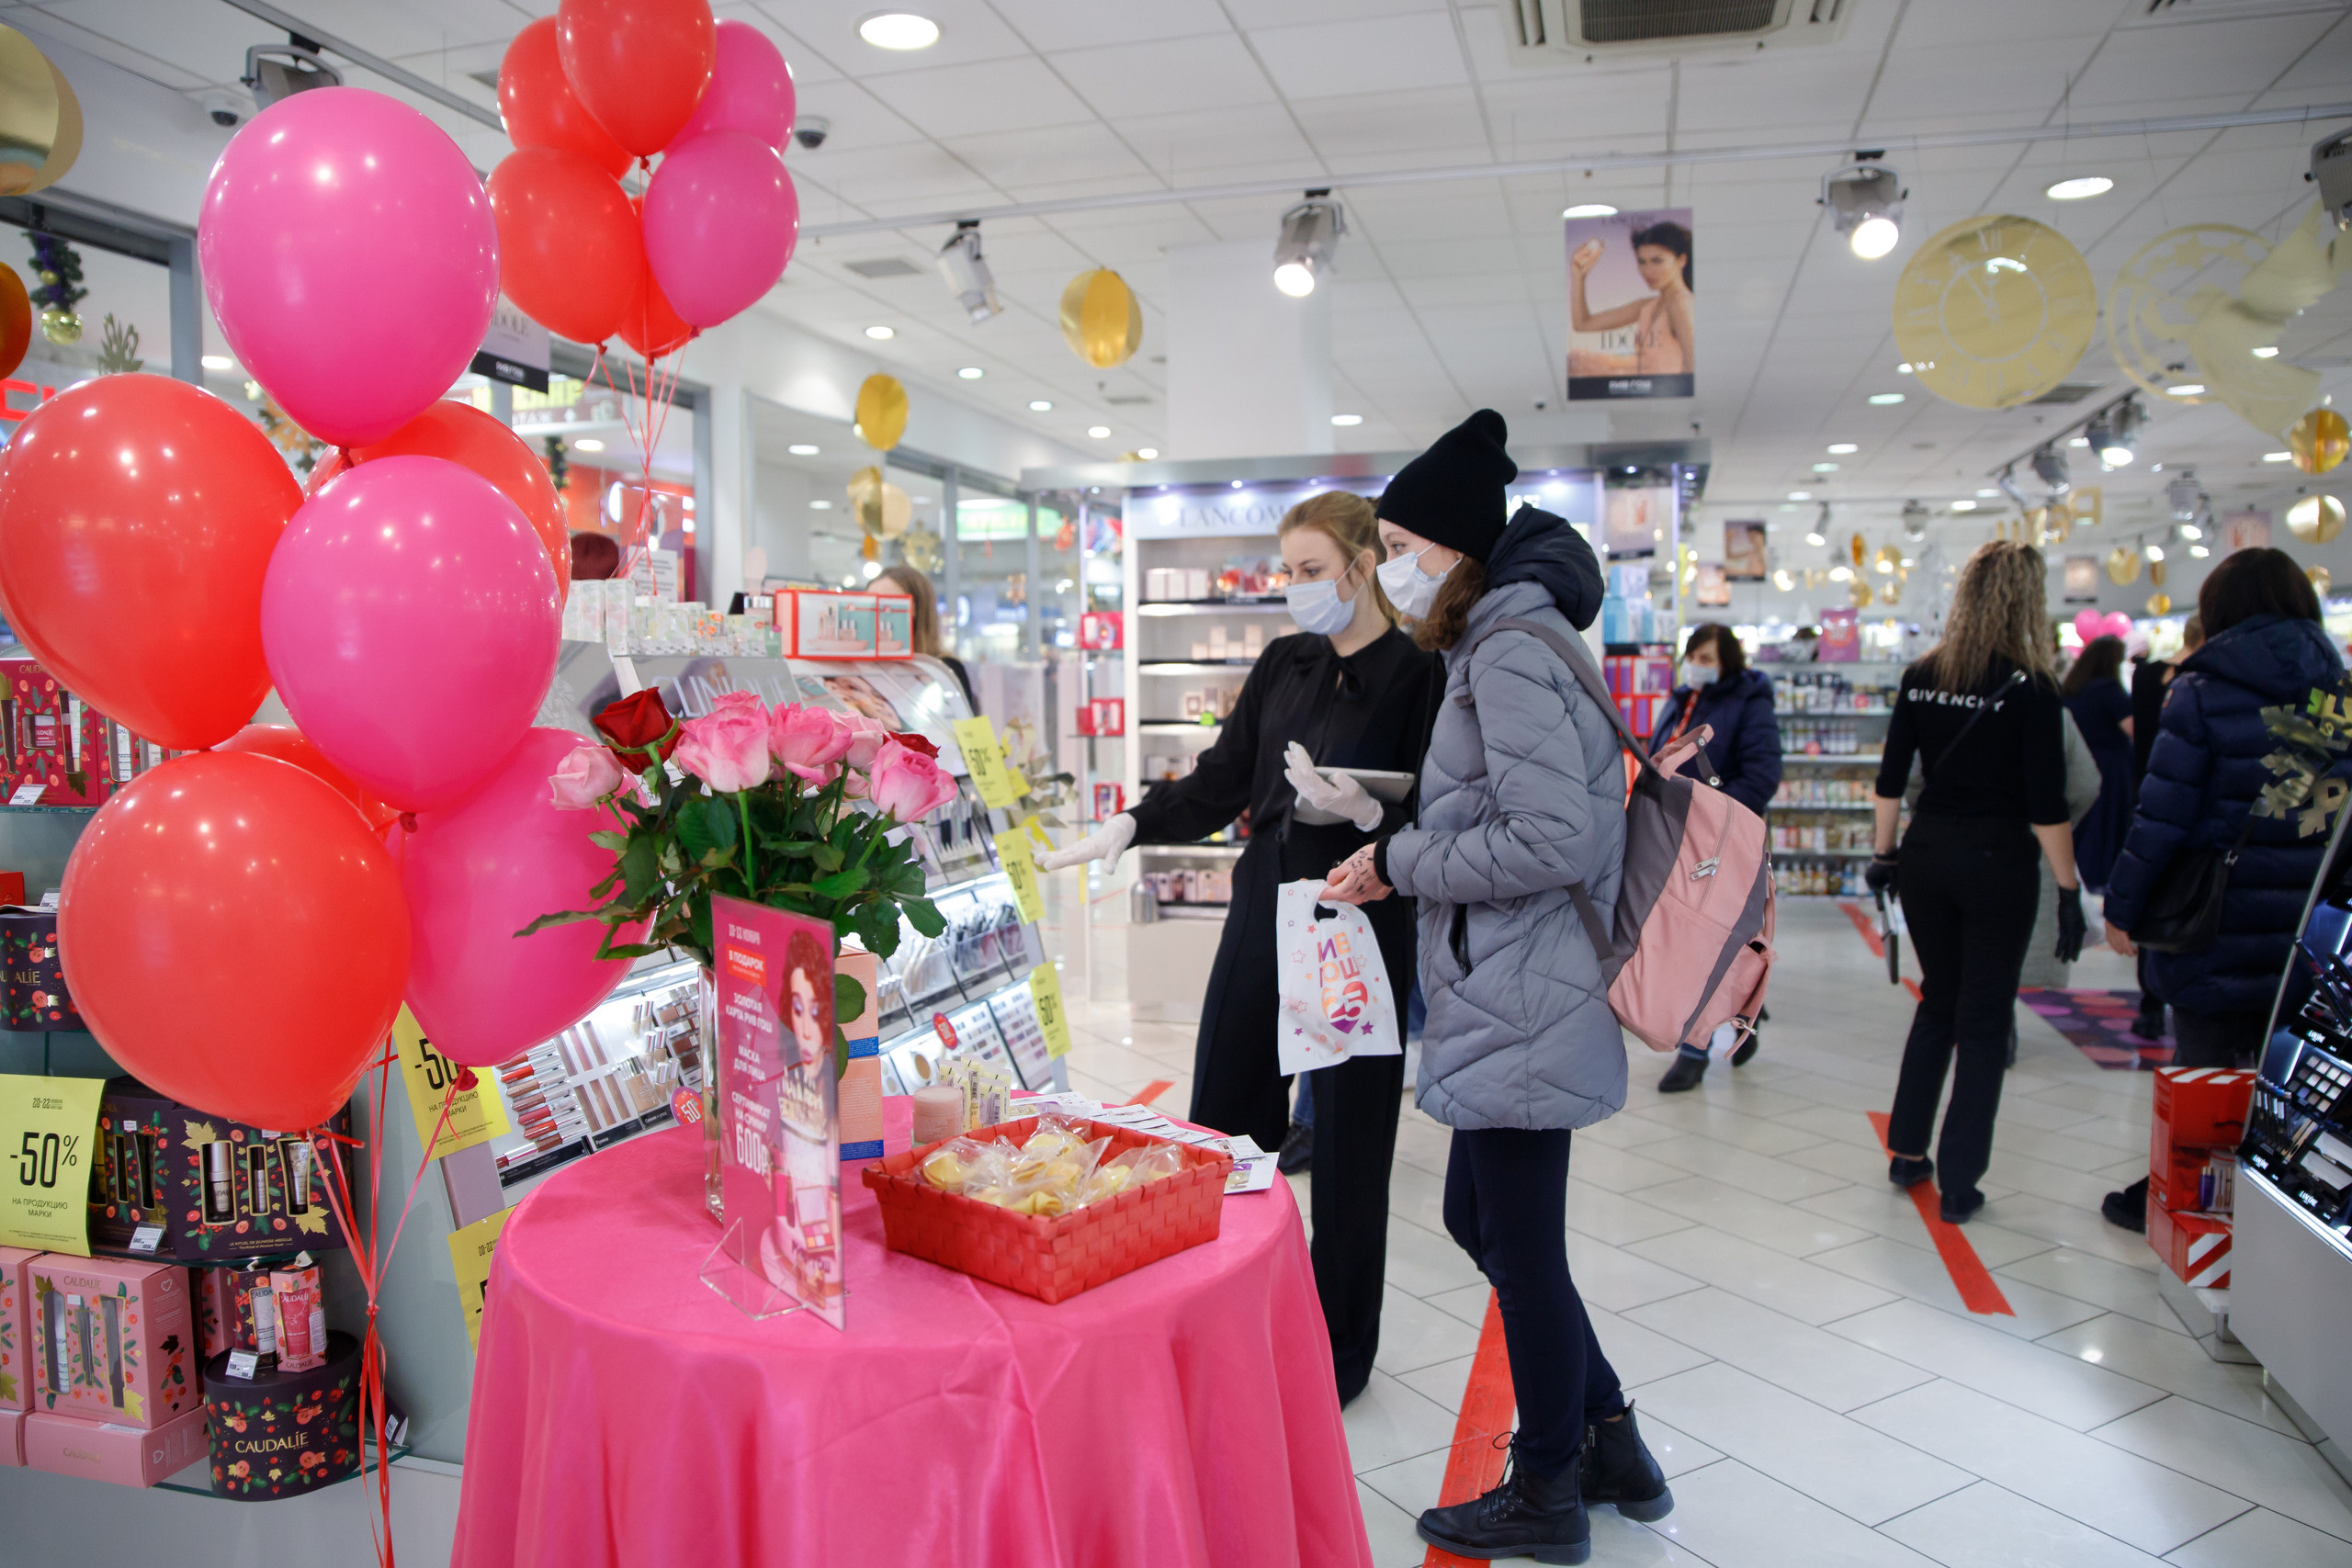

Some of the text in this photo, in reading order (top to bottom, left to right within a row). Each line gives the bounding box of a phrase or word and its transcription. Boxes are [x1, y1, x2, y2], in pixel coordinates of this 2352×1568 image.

[18, 664, 46, 674] CAUDA
[734, 951, 764, 972] ПОДАРОК
[733, 992, 763, 1013] ЗОЛОТАЯ
[725, 1004, 774, 1033] КАРТА РИВ ГОШ
[738, 1044, 761, 1065] МАСКА
[733, 1057, 767, 1082] ДЛЯ ЛИЦА
[32, 1097, 51, 1110] 20-22
[428, 1091, 479, 1112] НА ПДУКЦИЮ
[731, 1091, 772, 1120] СЕРТИФИКАТ
[735, 1107, 768, 1133] НА СУММУ
[10, 1132, 80, 1188] -50%
[23, 1198, 68, 1210] ПРОДУКЦИЮ
[28, 1209, 52, 1218] МАРКИ
[251, 1289, 273, 1299] CAUDA
